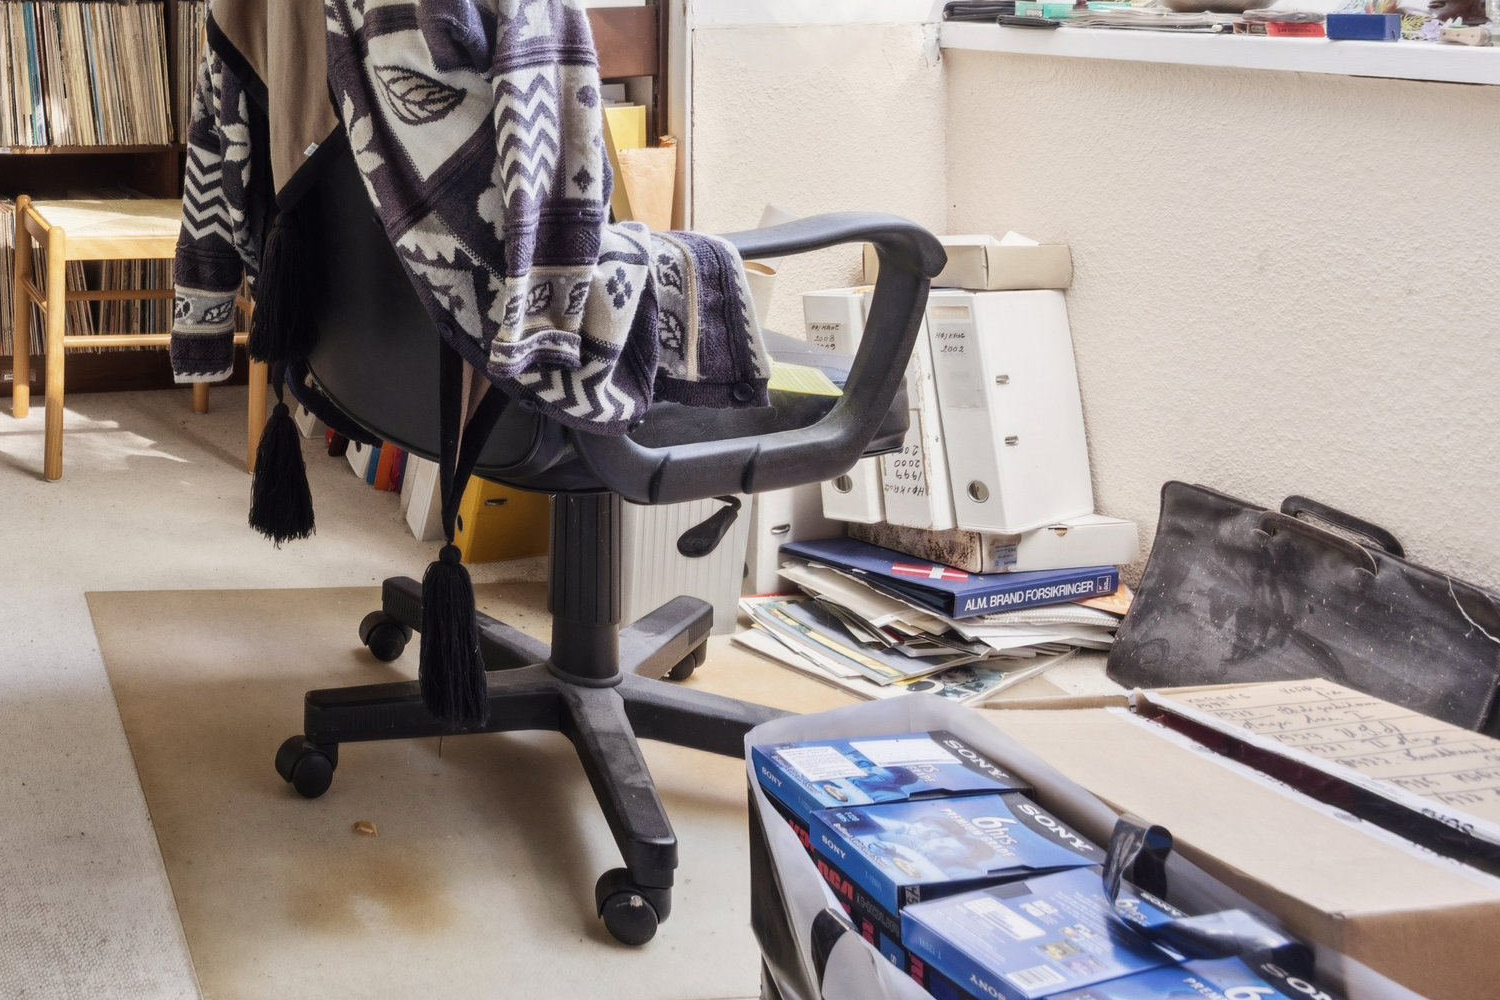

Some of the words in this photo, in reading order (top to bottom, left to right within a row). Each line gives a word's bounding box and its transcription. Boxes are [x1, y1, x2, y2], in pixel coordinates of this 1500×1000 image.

[940, 345, 965, 353] 2002
[894, 459, 920, 468] 2000
[895, 469, 922, 480] 1999
[964, 599, 988, 612] ALM.
[990, 591, 1024, 607] BRAND
[1025, 580, 1094, 602] FORSIKRINGER
[943, 739, 1010, 780] SONY
[761, 766, 783, 788] SONY
[971, 816, 1018, 845] 6hrs
[1017, 803, 1095, 852] SONY
[821, 834, 846, 859] SONY
[817, 859, 854, 902] RCA
[969, 973, 1007, 1000] SONY
